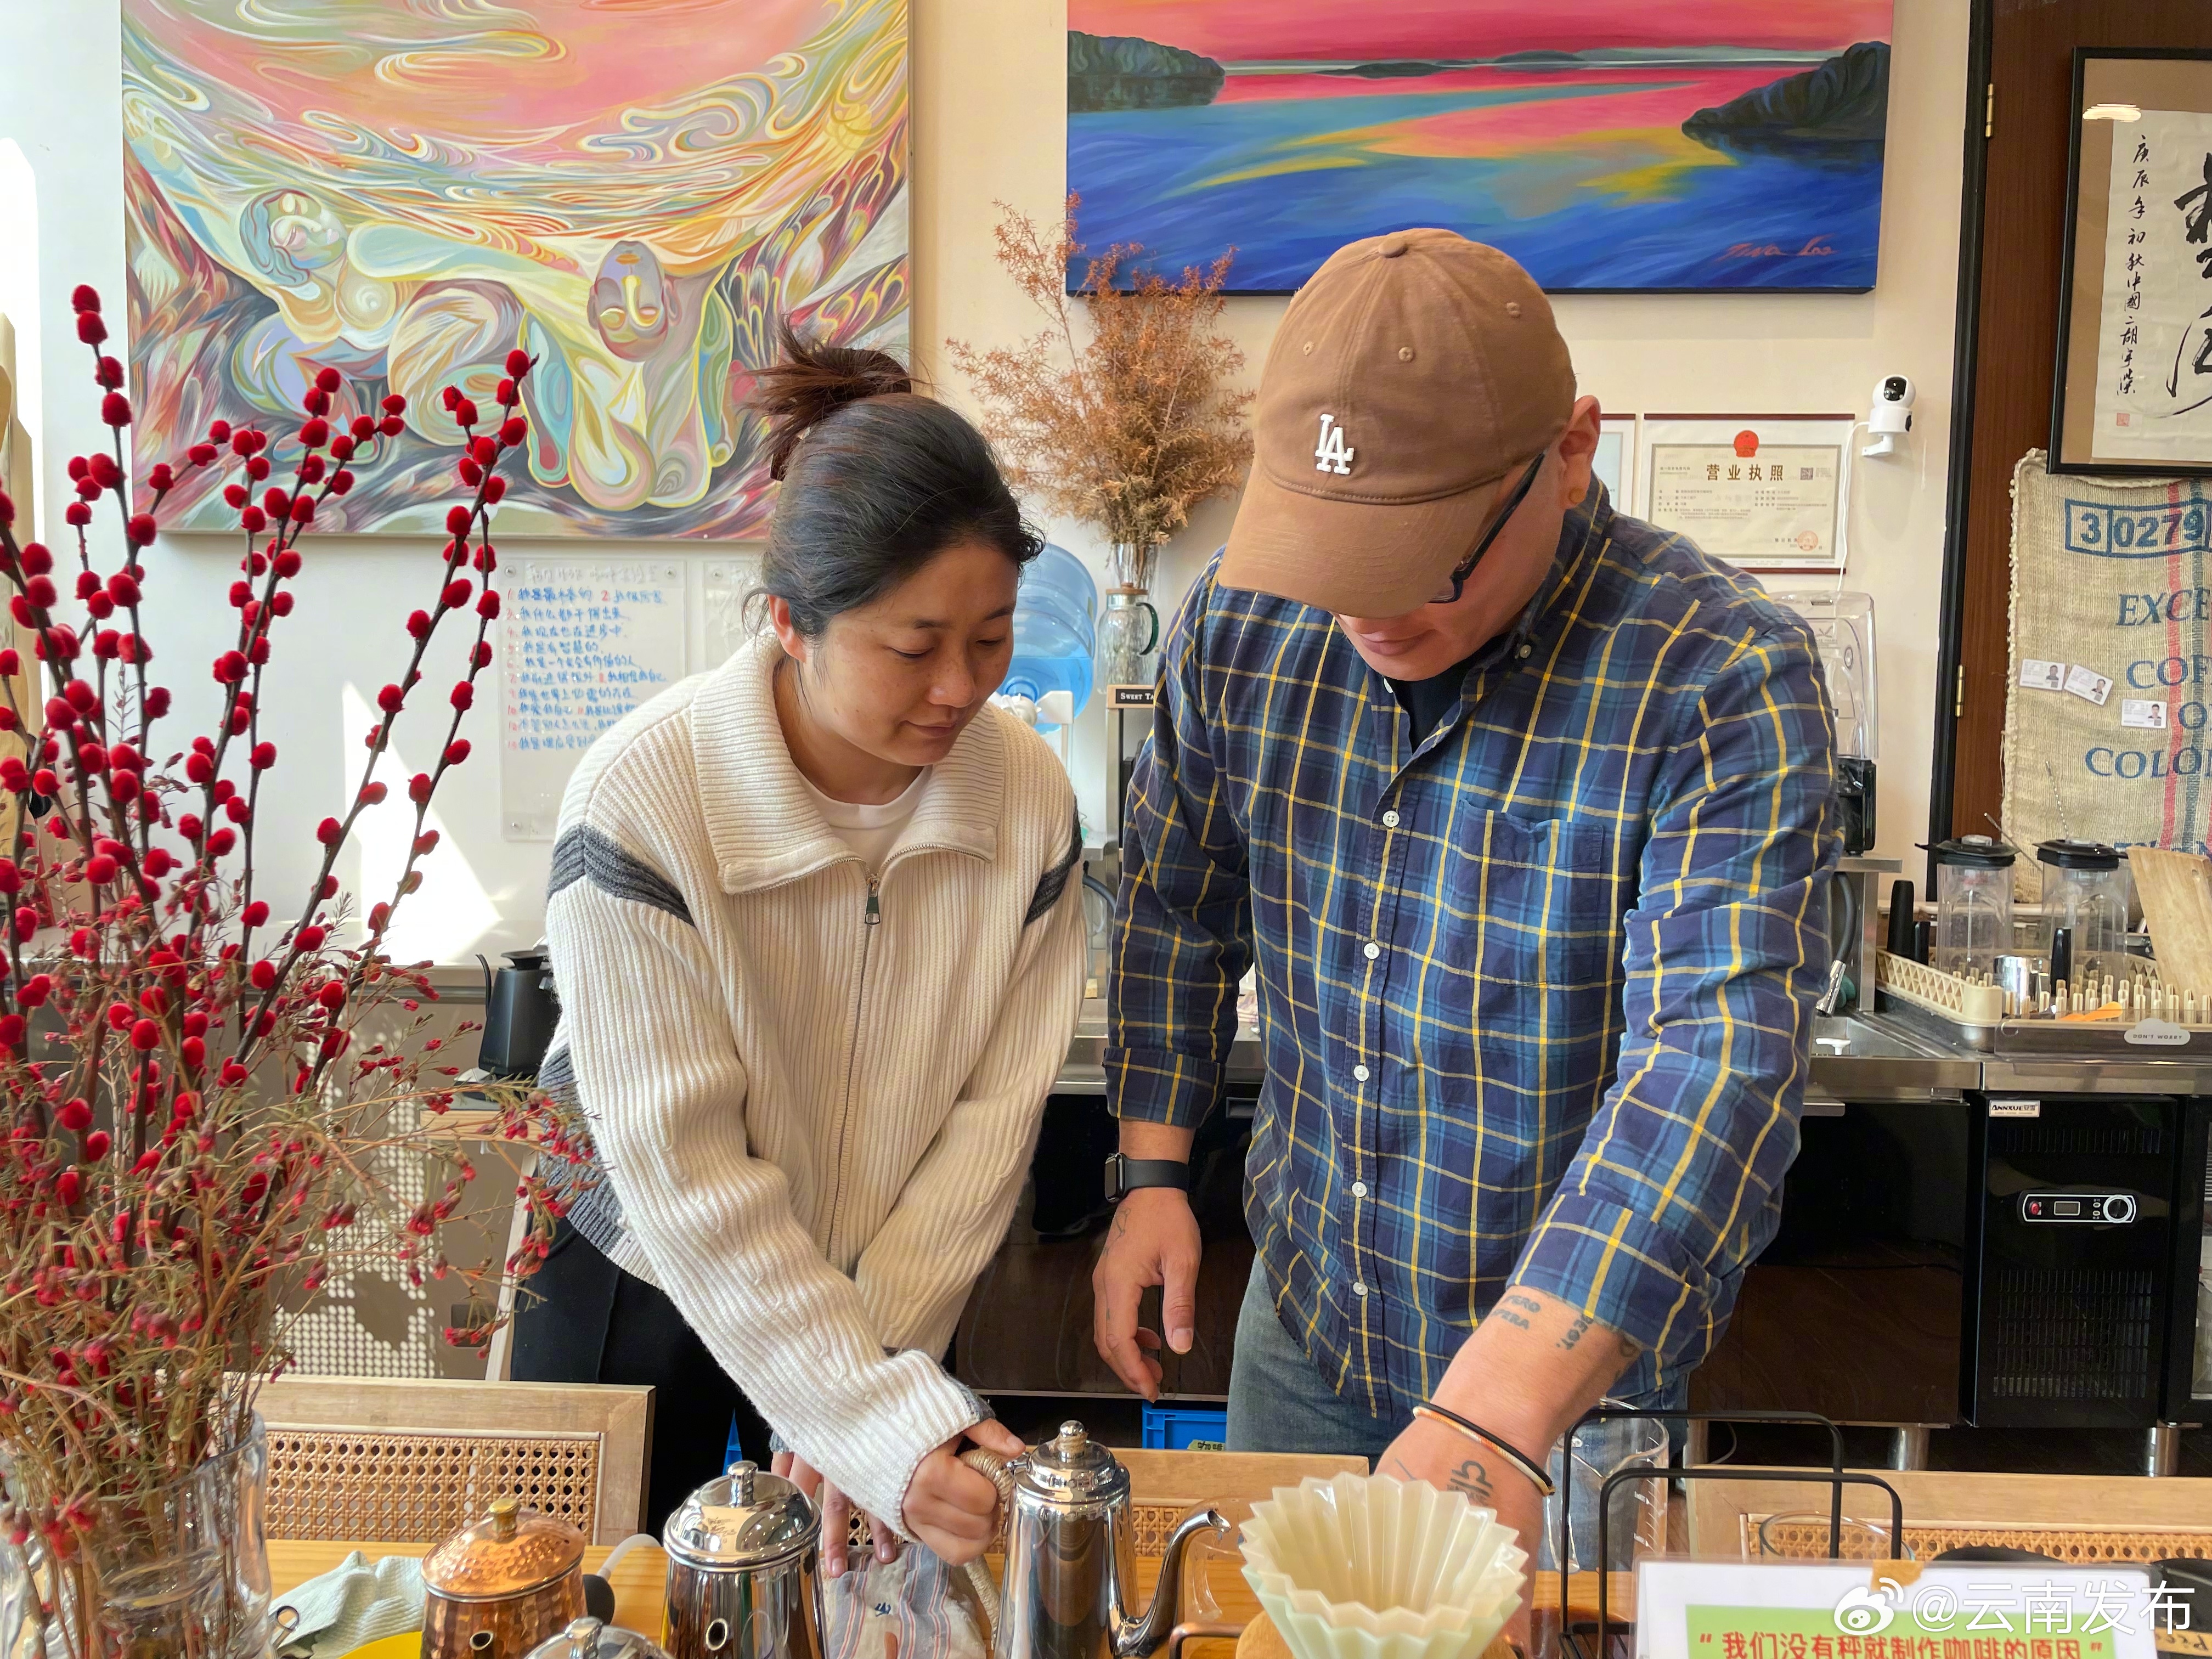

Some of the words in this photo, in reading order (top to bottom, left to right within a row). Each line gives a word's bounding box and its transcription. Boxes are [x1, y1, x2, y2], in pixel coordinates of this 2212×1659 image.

[1315, 413, 1355, 475] LA
[1707, 464, 1783, 481] 营业执照
[2081, 513, 2101, 544] 3
[2113, 508, 2204, 548] 0279
